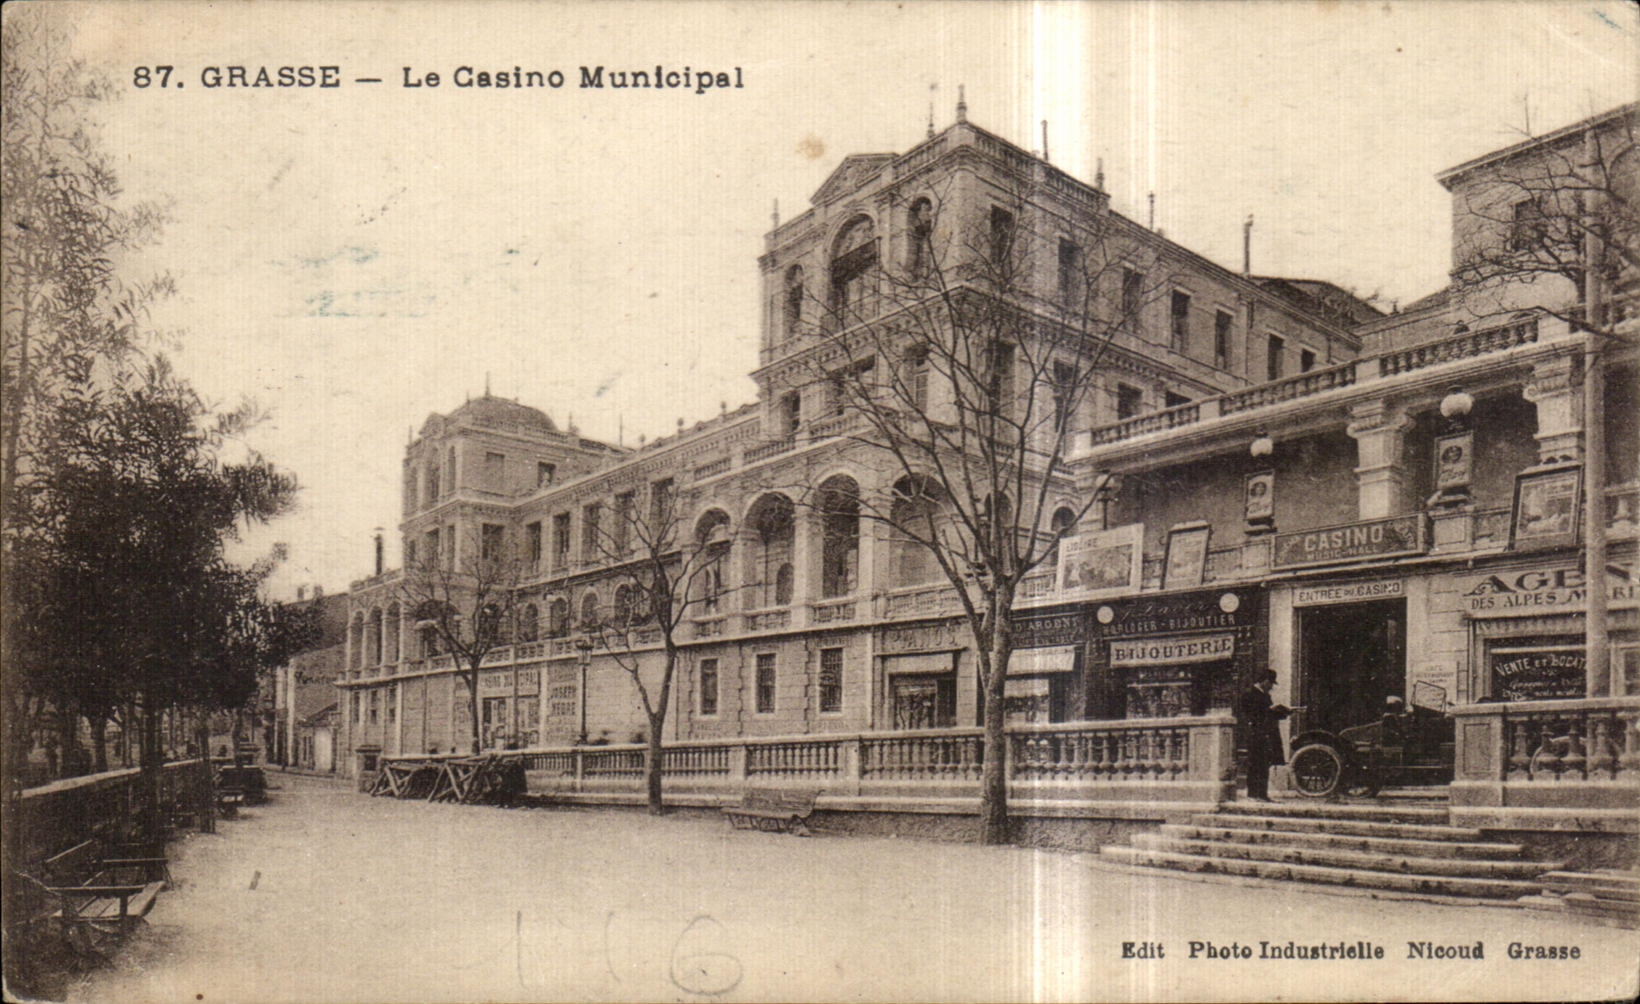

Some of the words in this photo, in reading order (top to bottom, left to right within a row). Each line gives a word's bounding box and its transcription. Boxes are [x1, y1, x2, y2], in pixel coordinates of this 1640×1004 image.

[1304, 524, 1384, 552] CASINO
[1299, 587, 1342, 602] ENTREE
[1356, 582, 1401, 597] CASINO
[1471, 598, 1496, 610] DES
[1503, 592, 1557, 608] ALPES
[1169, 613, 1236, 630] BIJOUTIER
[1114, 638, 1232, 661] BIJOUTERIE
[1495, 657, 1531, 677] VENTE
